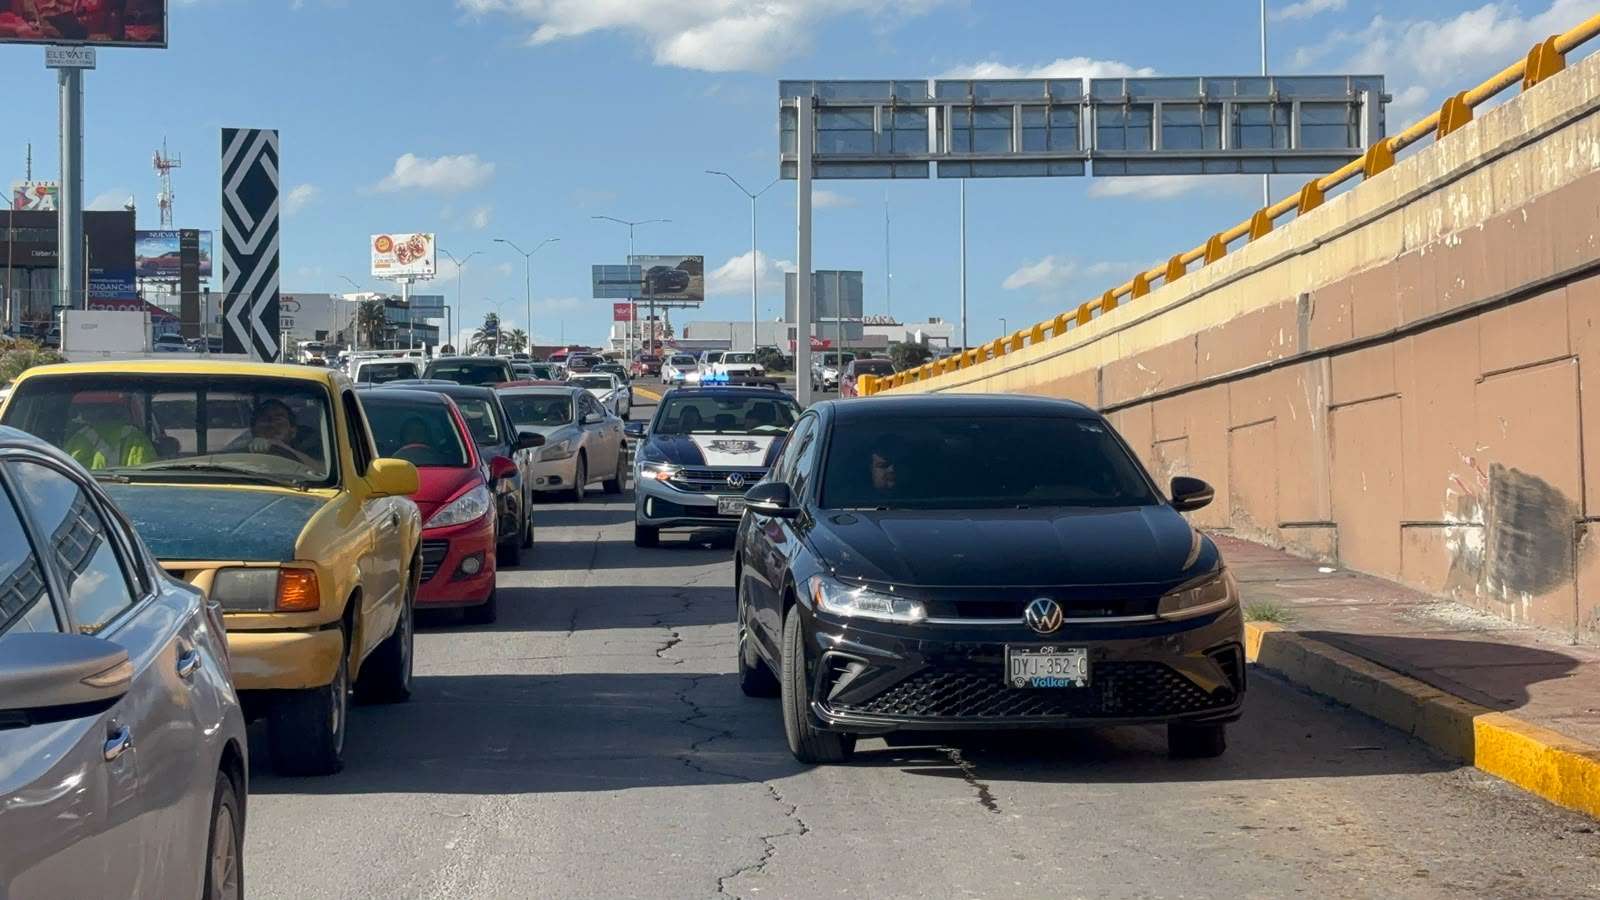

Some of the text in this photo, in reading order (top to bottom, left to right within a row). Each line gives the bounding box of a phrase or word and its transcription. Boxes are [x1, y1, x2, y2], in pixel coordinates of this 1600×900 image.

[47, 47, 92, 59] ELEVATE
[1013, 657, 1087, 675] DYJ-352-C
[1031, 677, 1070, 687] Volker
